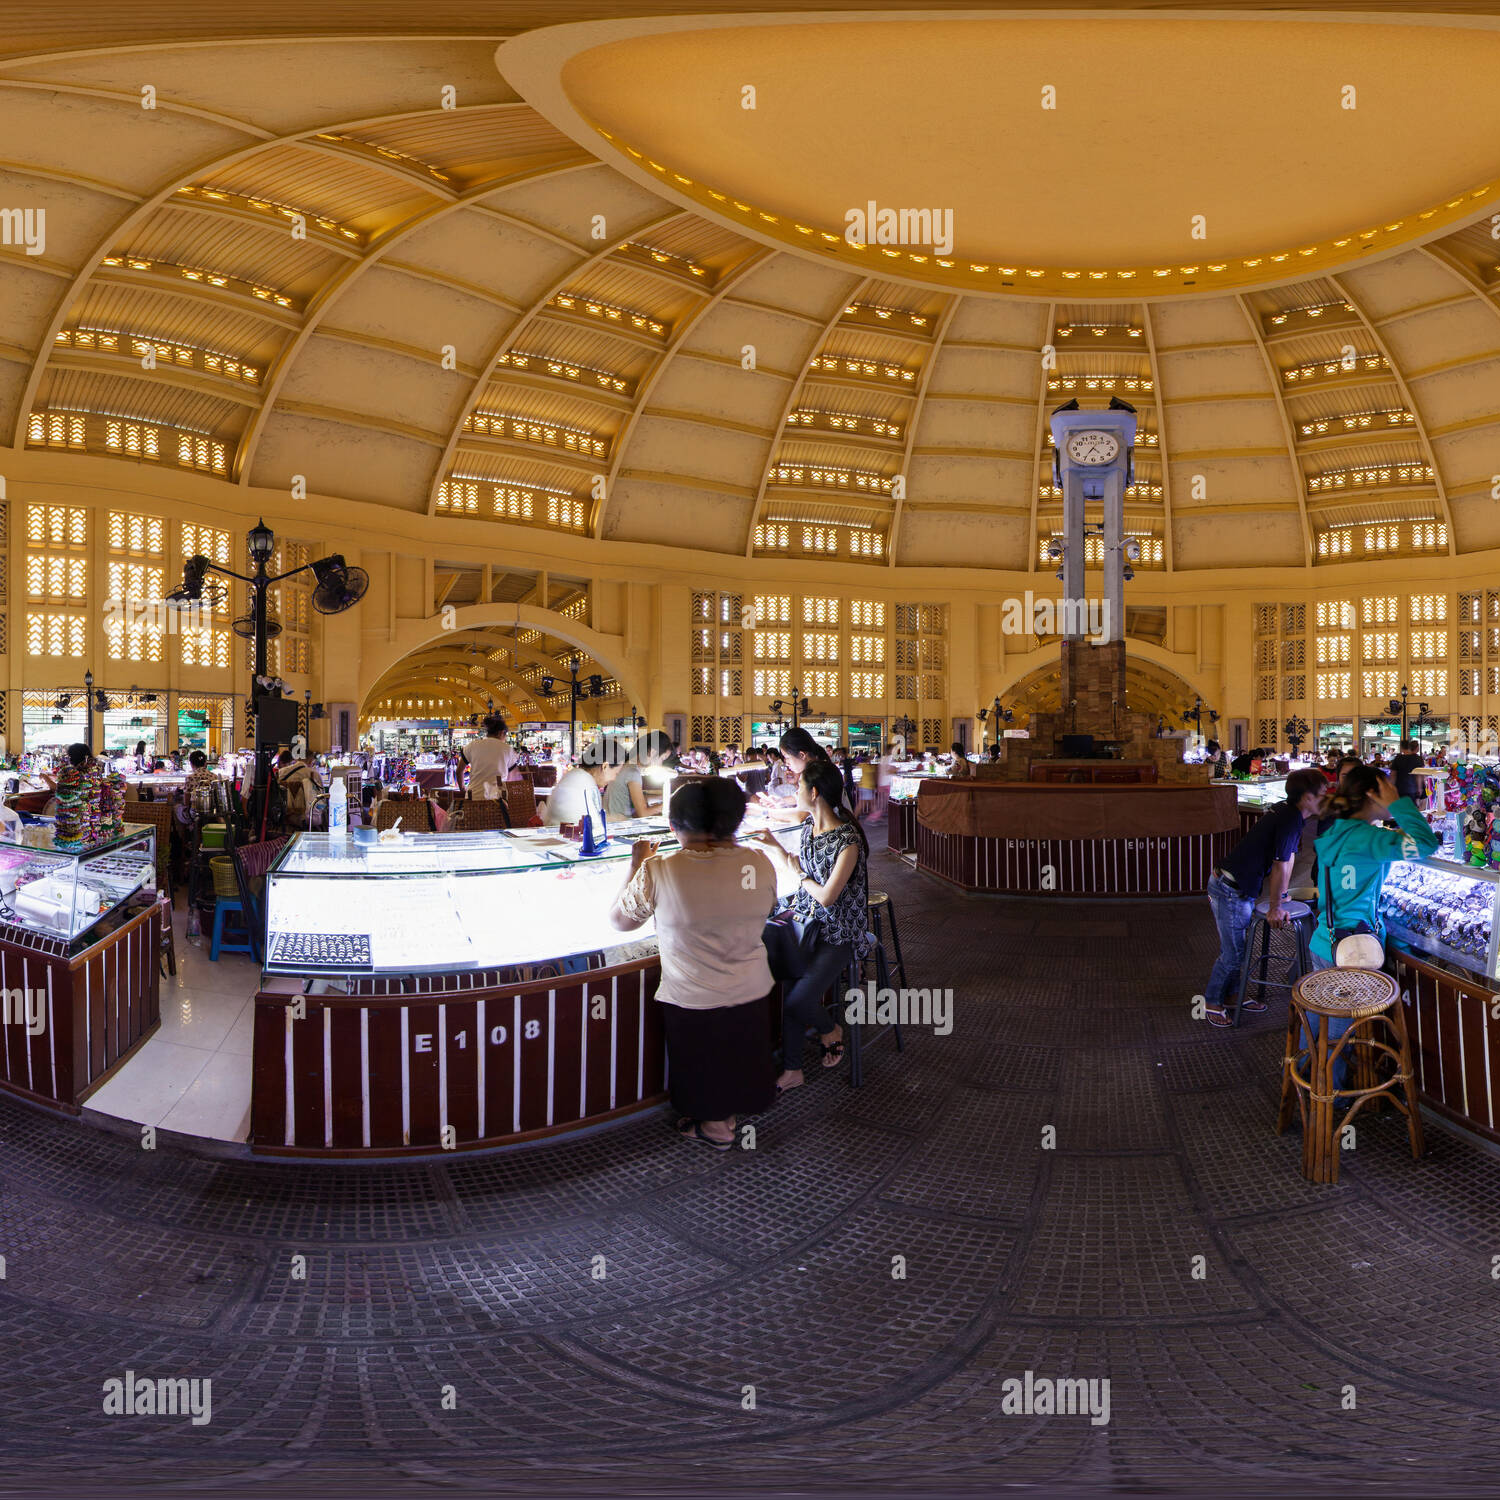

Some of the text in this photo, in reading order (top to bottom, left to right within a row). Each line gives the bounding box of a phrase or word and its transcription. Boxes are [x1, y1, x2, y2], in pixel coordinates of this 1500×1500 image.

[1009, 840, 1047, 849] E011
[1127, 841, 1166, 850] E010
[415, 1018, 541, 1053] E108
